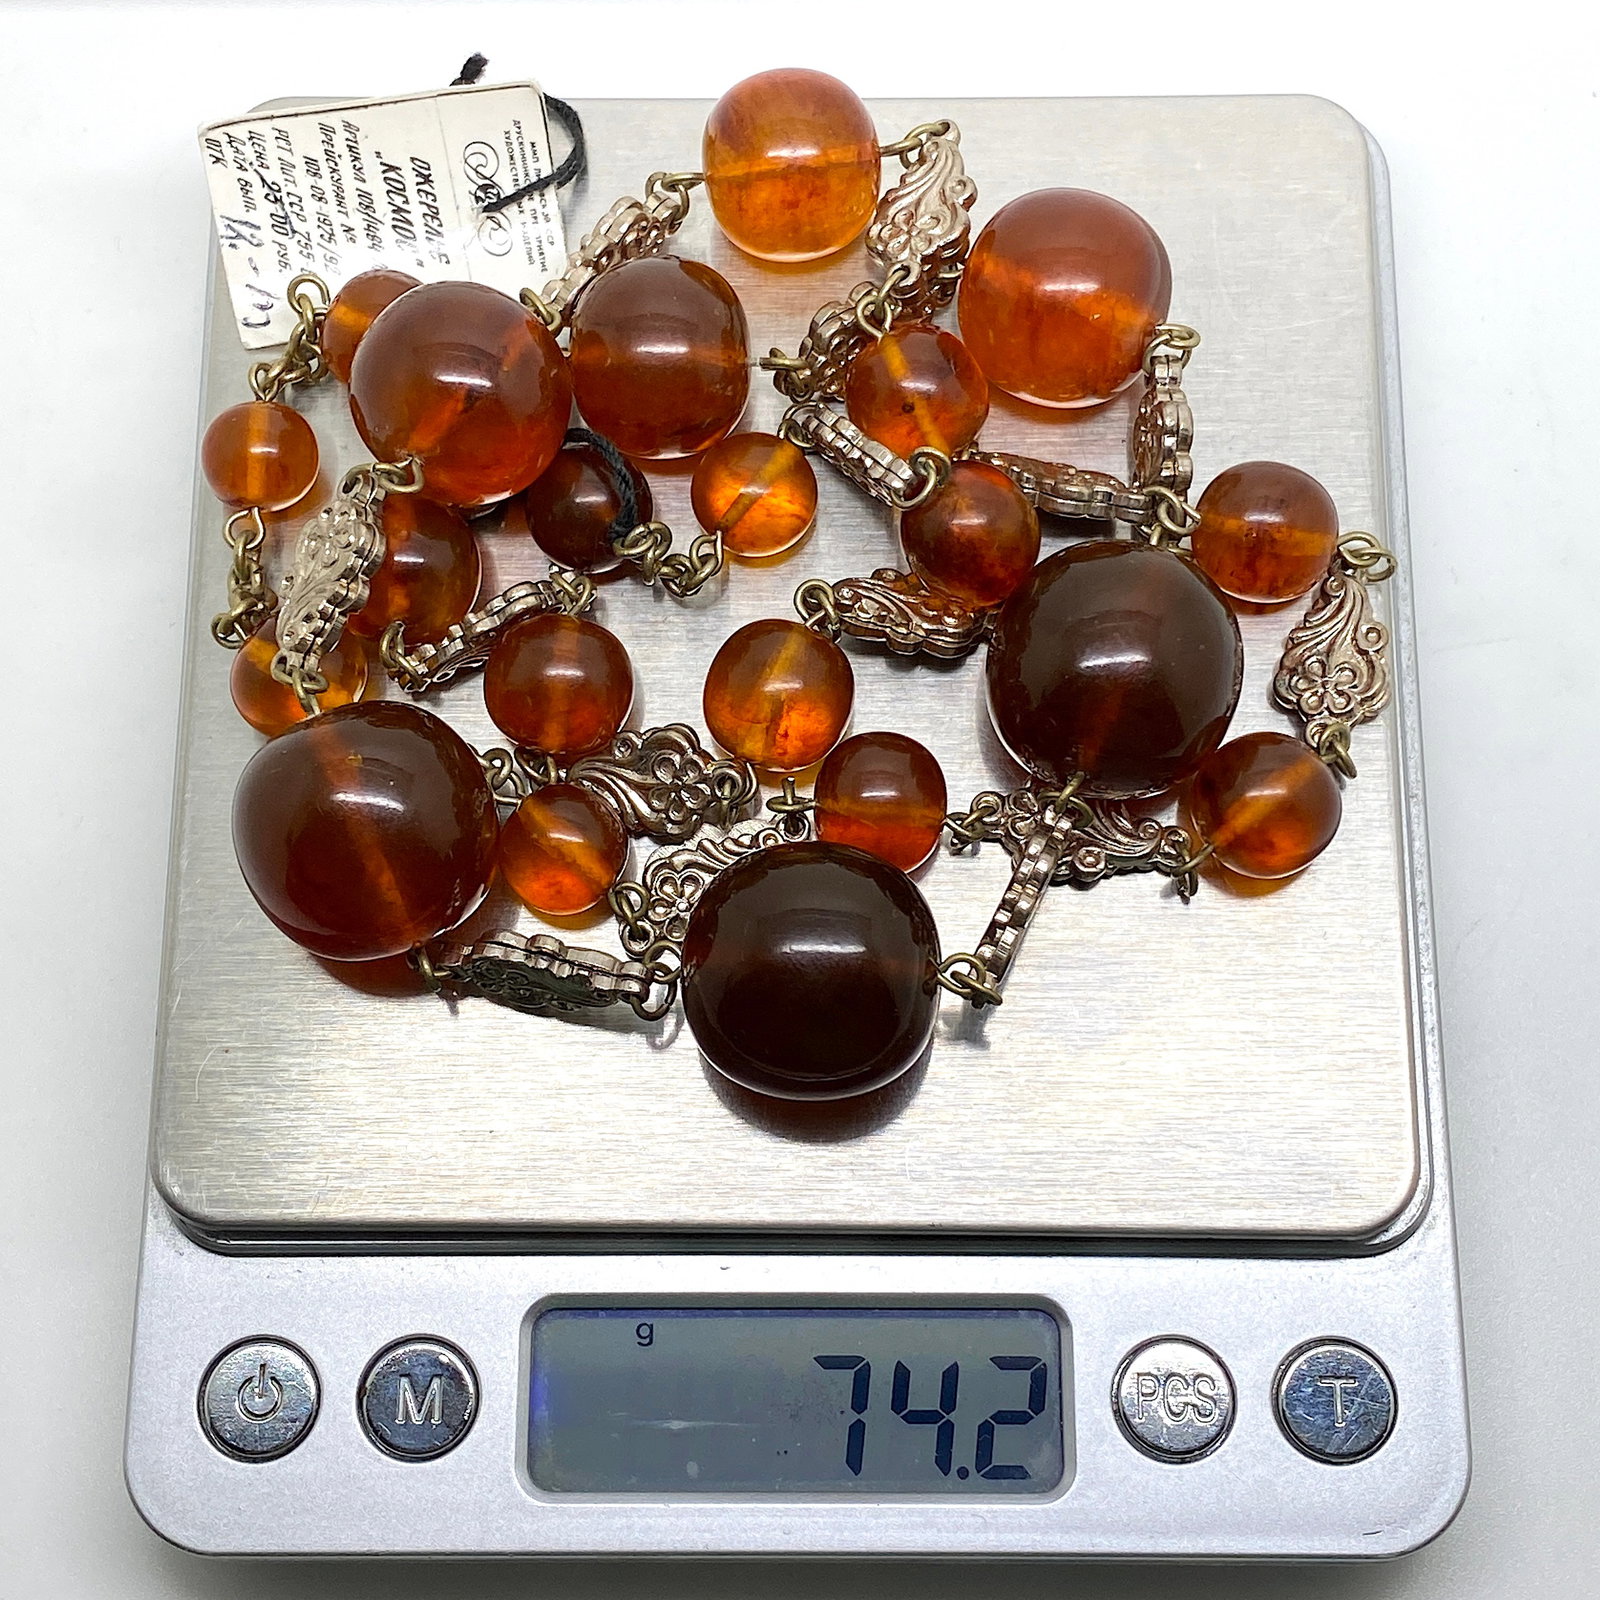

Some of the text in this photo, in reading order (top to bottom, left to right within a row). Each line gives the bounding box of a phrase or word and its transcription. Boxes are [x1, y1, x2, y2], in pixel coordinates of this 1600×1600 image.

[205, 138, 227, 168] ОТК
[272, 127, 293, 156] РСТ
[286, 192, 307, 222] ССР
[636, 1322, 654, 1347] g
[395, 1372, 444, 1425] M
[813, 1355, 1048, 1480] 74.2
[1135, 1371, 1217, 1424] PCS
[1317, 1374, 1357, 1428] T
